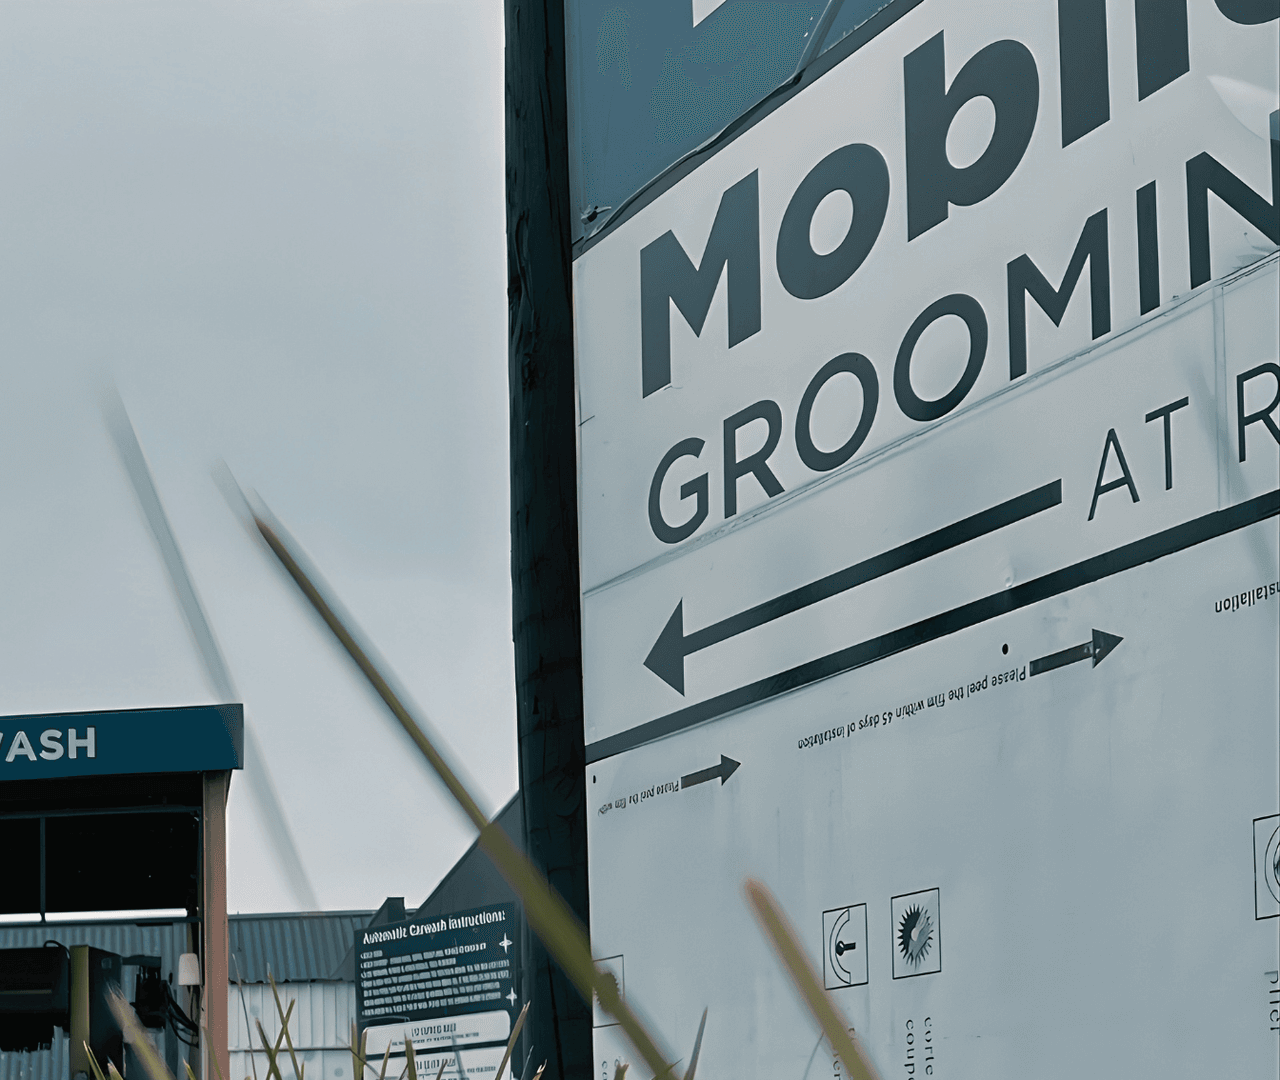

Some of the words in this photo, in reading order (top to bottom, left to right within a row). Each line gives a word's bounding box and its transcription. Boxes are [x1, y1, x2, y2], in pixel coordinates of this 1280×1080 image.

[640, 0, 1280, 399] Mobil
[1088, 396, 1190, 521] AT
[948, 686, 965, 702] the
